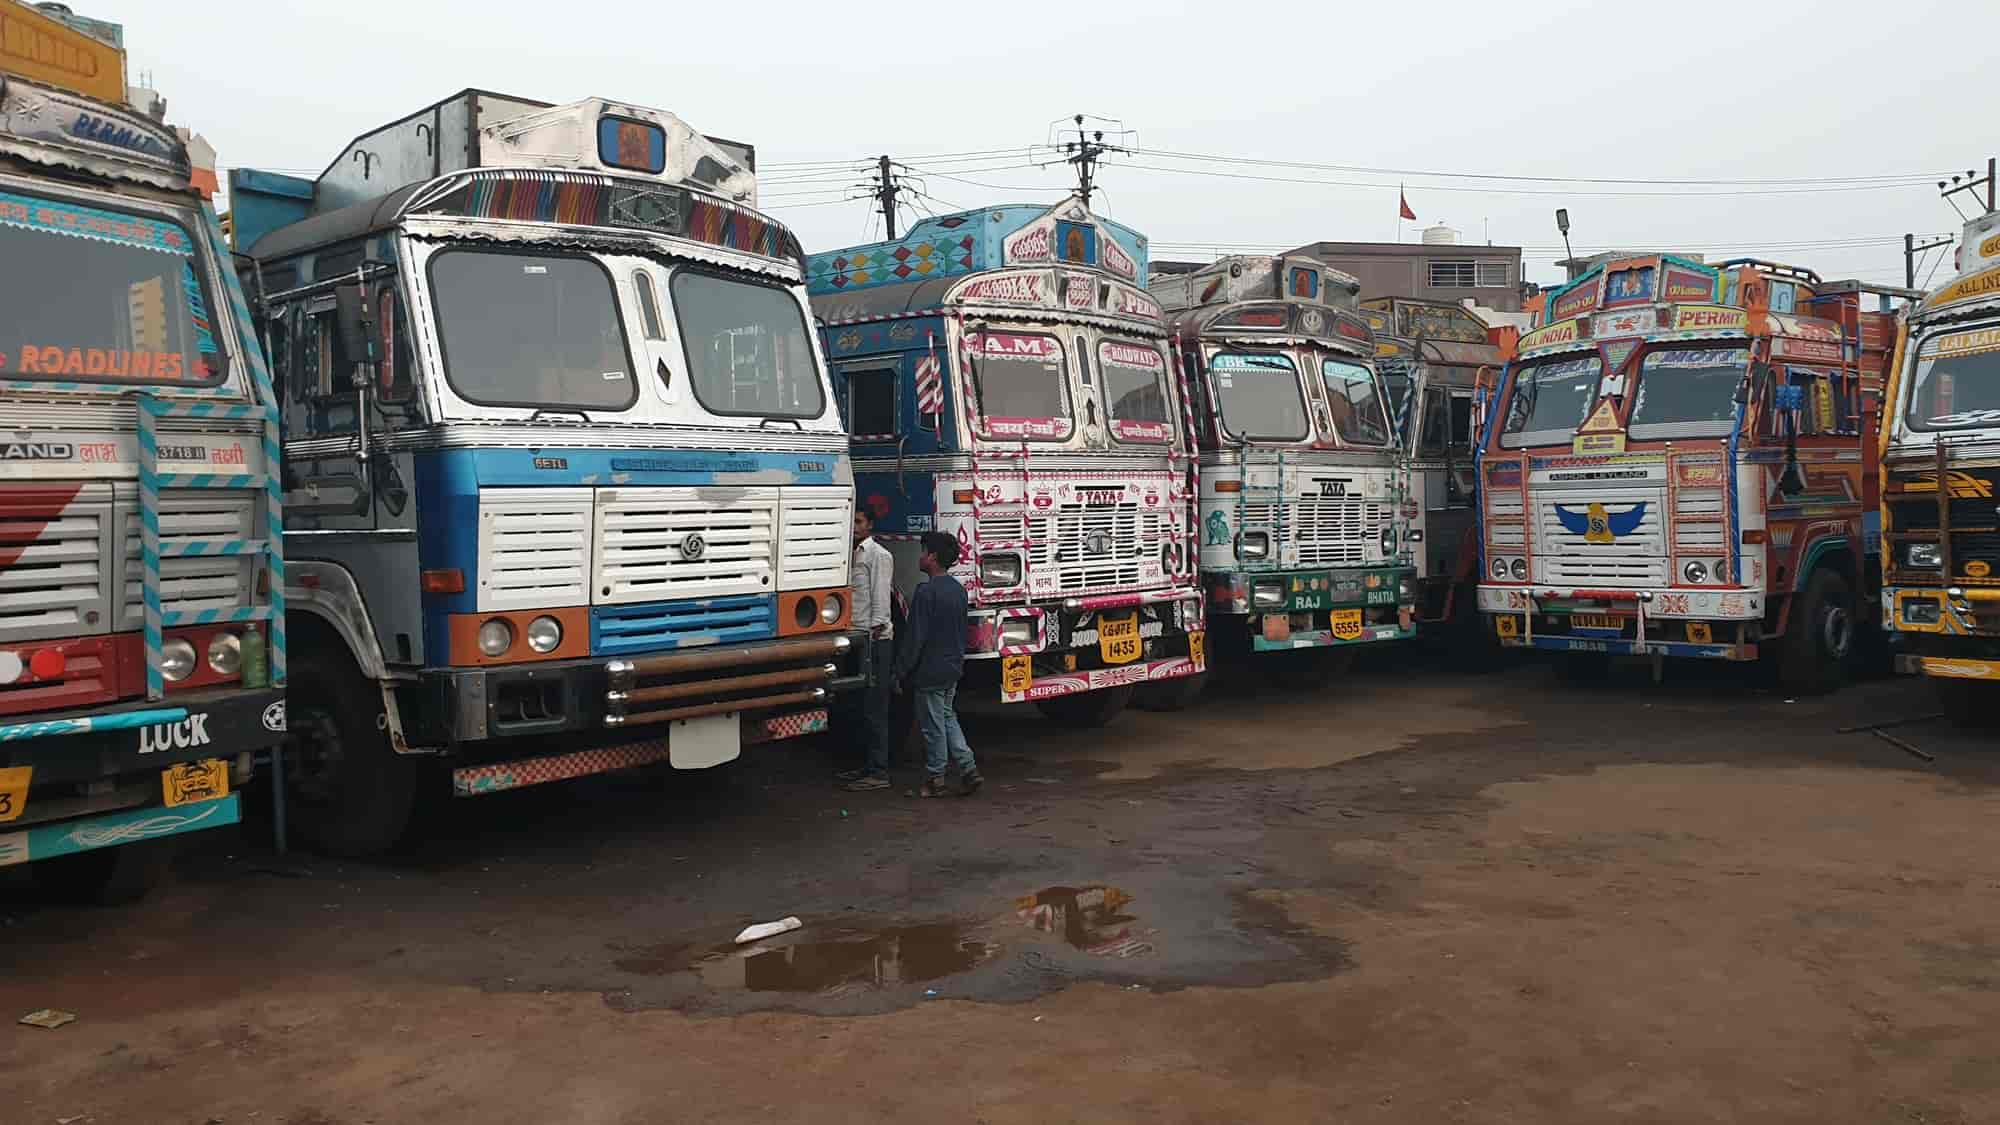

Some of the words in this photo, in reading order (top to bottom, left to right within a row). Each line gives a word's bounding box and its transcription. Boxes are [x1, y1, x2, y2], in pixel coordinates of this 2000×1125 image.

[72, 112, 154, 148] PERMIT
[1680, 309, 1743, 327] PERMIT
[1540, 327, 1573, 345] INDIA
[985, 337, 1043, 355] A.M
[18, 343, 182, 379] ROADLINES
[1111, 346, 1154, 366] ROADWAYS
[0, 443, 71, 459] AND
[1593, 470, 1646, 480] LEYLAND
[1320, 482, 1346, 496] TATA
[1295, 596, 1321, 609] RAJ
[1367, 591, 1394, 604] BHATIA
[1335, 622, 1360, 635] 5555
[1108, 640, 1136, 658] 1435
[1029, 684, 1066, 698] SUPER
[138, 713, 210, 754] LUCK
